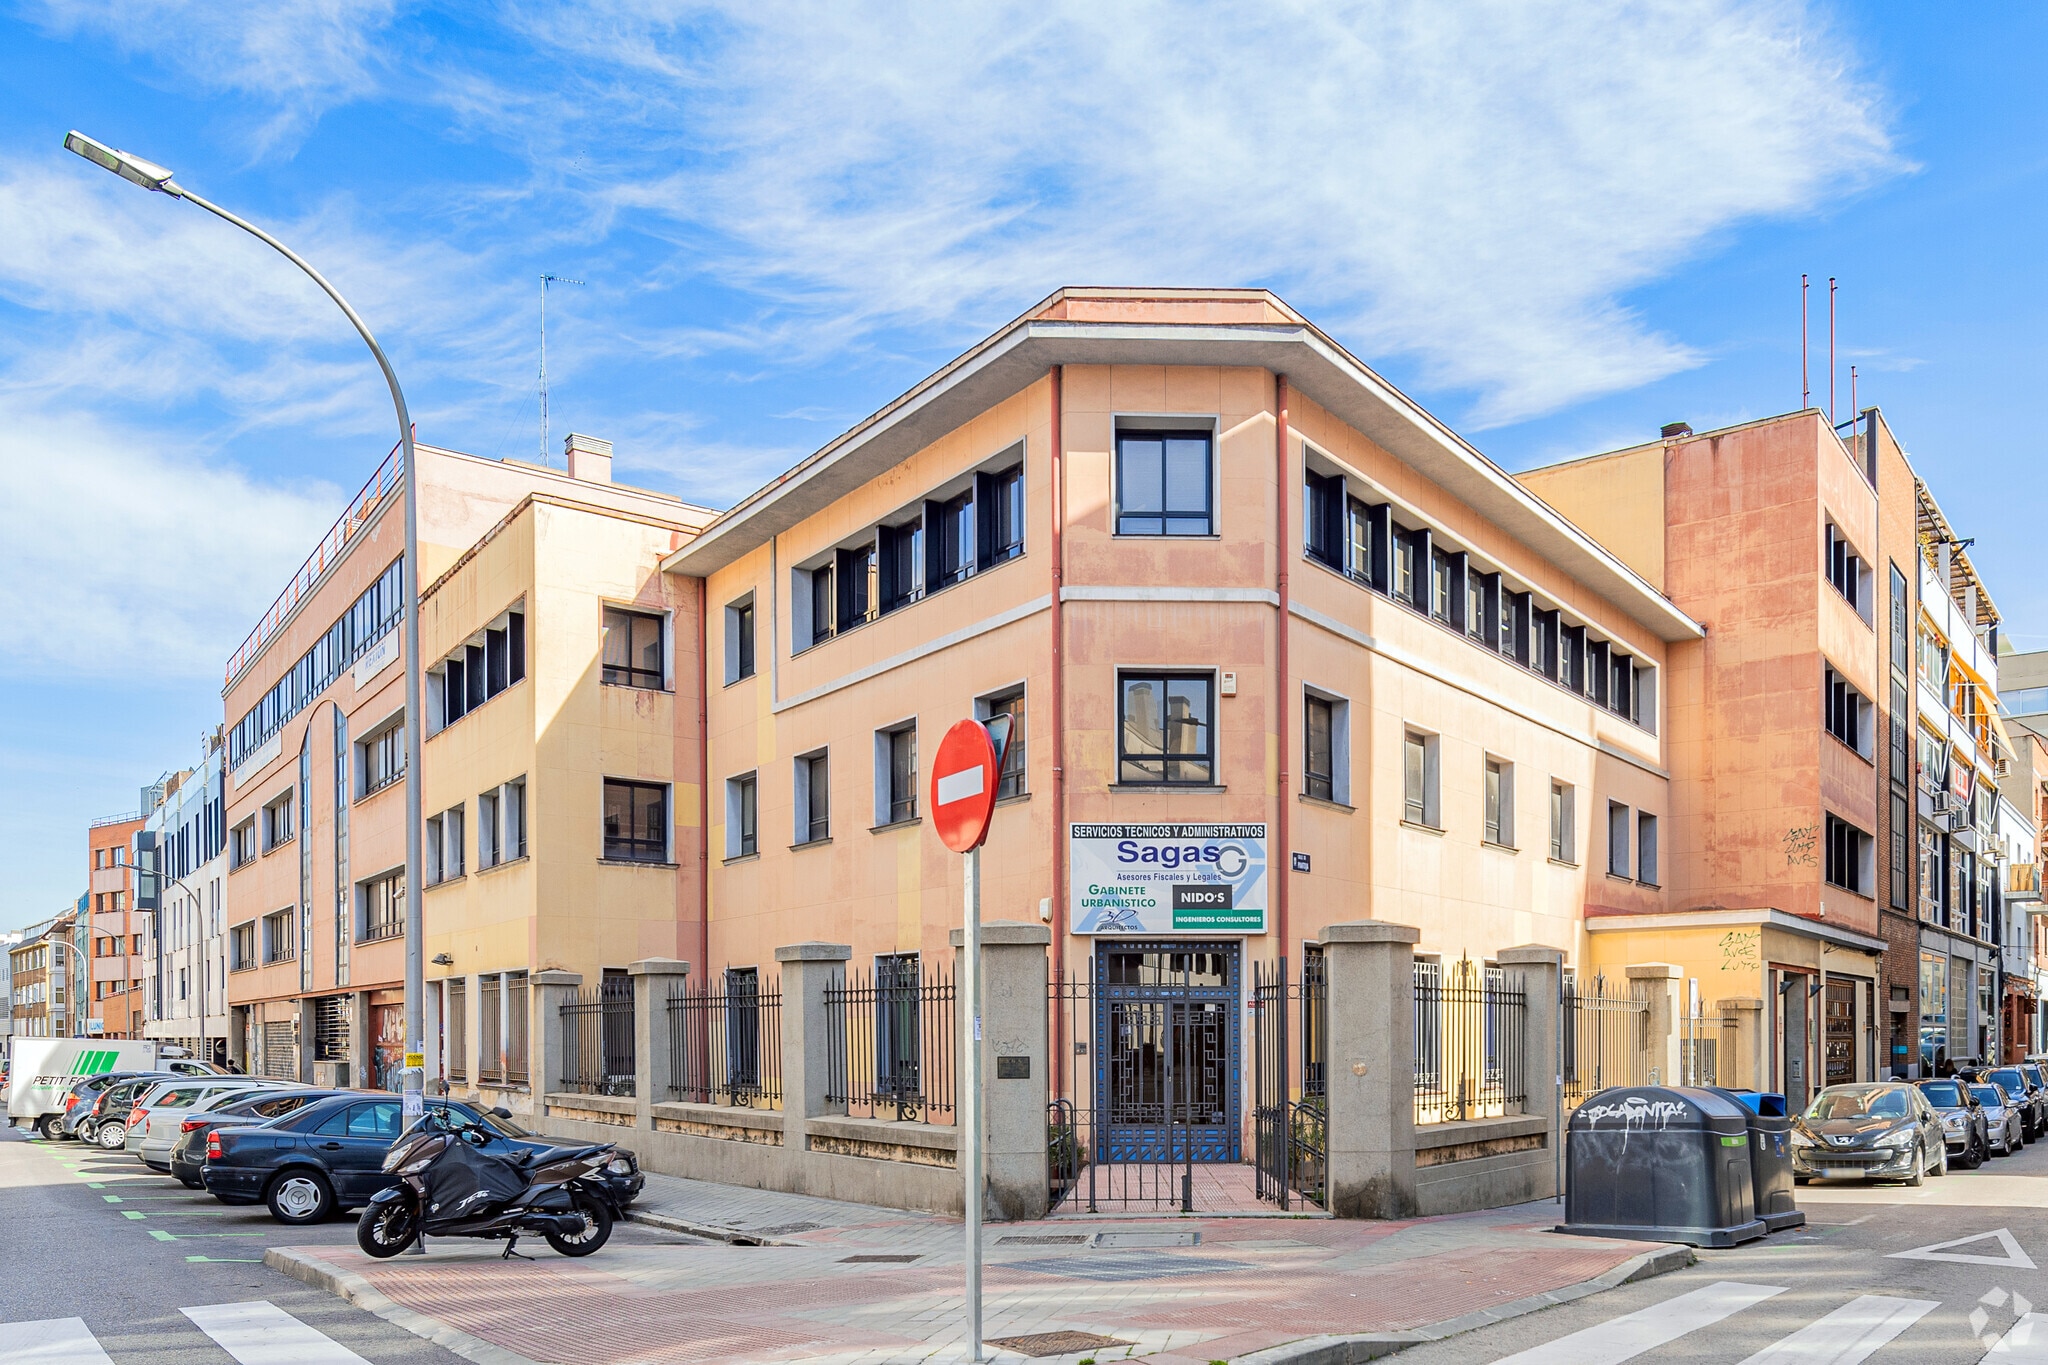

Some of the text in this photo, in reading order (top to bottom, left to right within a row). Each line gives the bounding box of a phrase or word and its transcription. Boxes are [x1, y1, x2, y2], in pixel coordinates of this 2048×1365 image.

[1073, 825, 1264, 838] SERVICIOS TECNICOS Y ADMINISTRATIVOS
[1117, 840, 1221, 869] Sagas
[1116, 872, 1222, 883] Asesores Fiscales y Legales
[1081, 898, 1156, 908] URBANISTICO
[1180, 892, 1225, 903] NIDO'S
[1175, 915, 1262, 923] INGENIEROS CONSULTORES
[33, 1075, 85, 1085] PETIT FO
